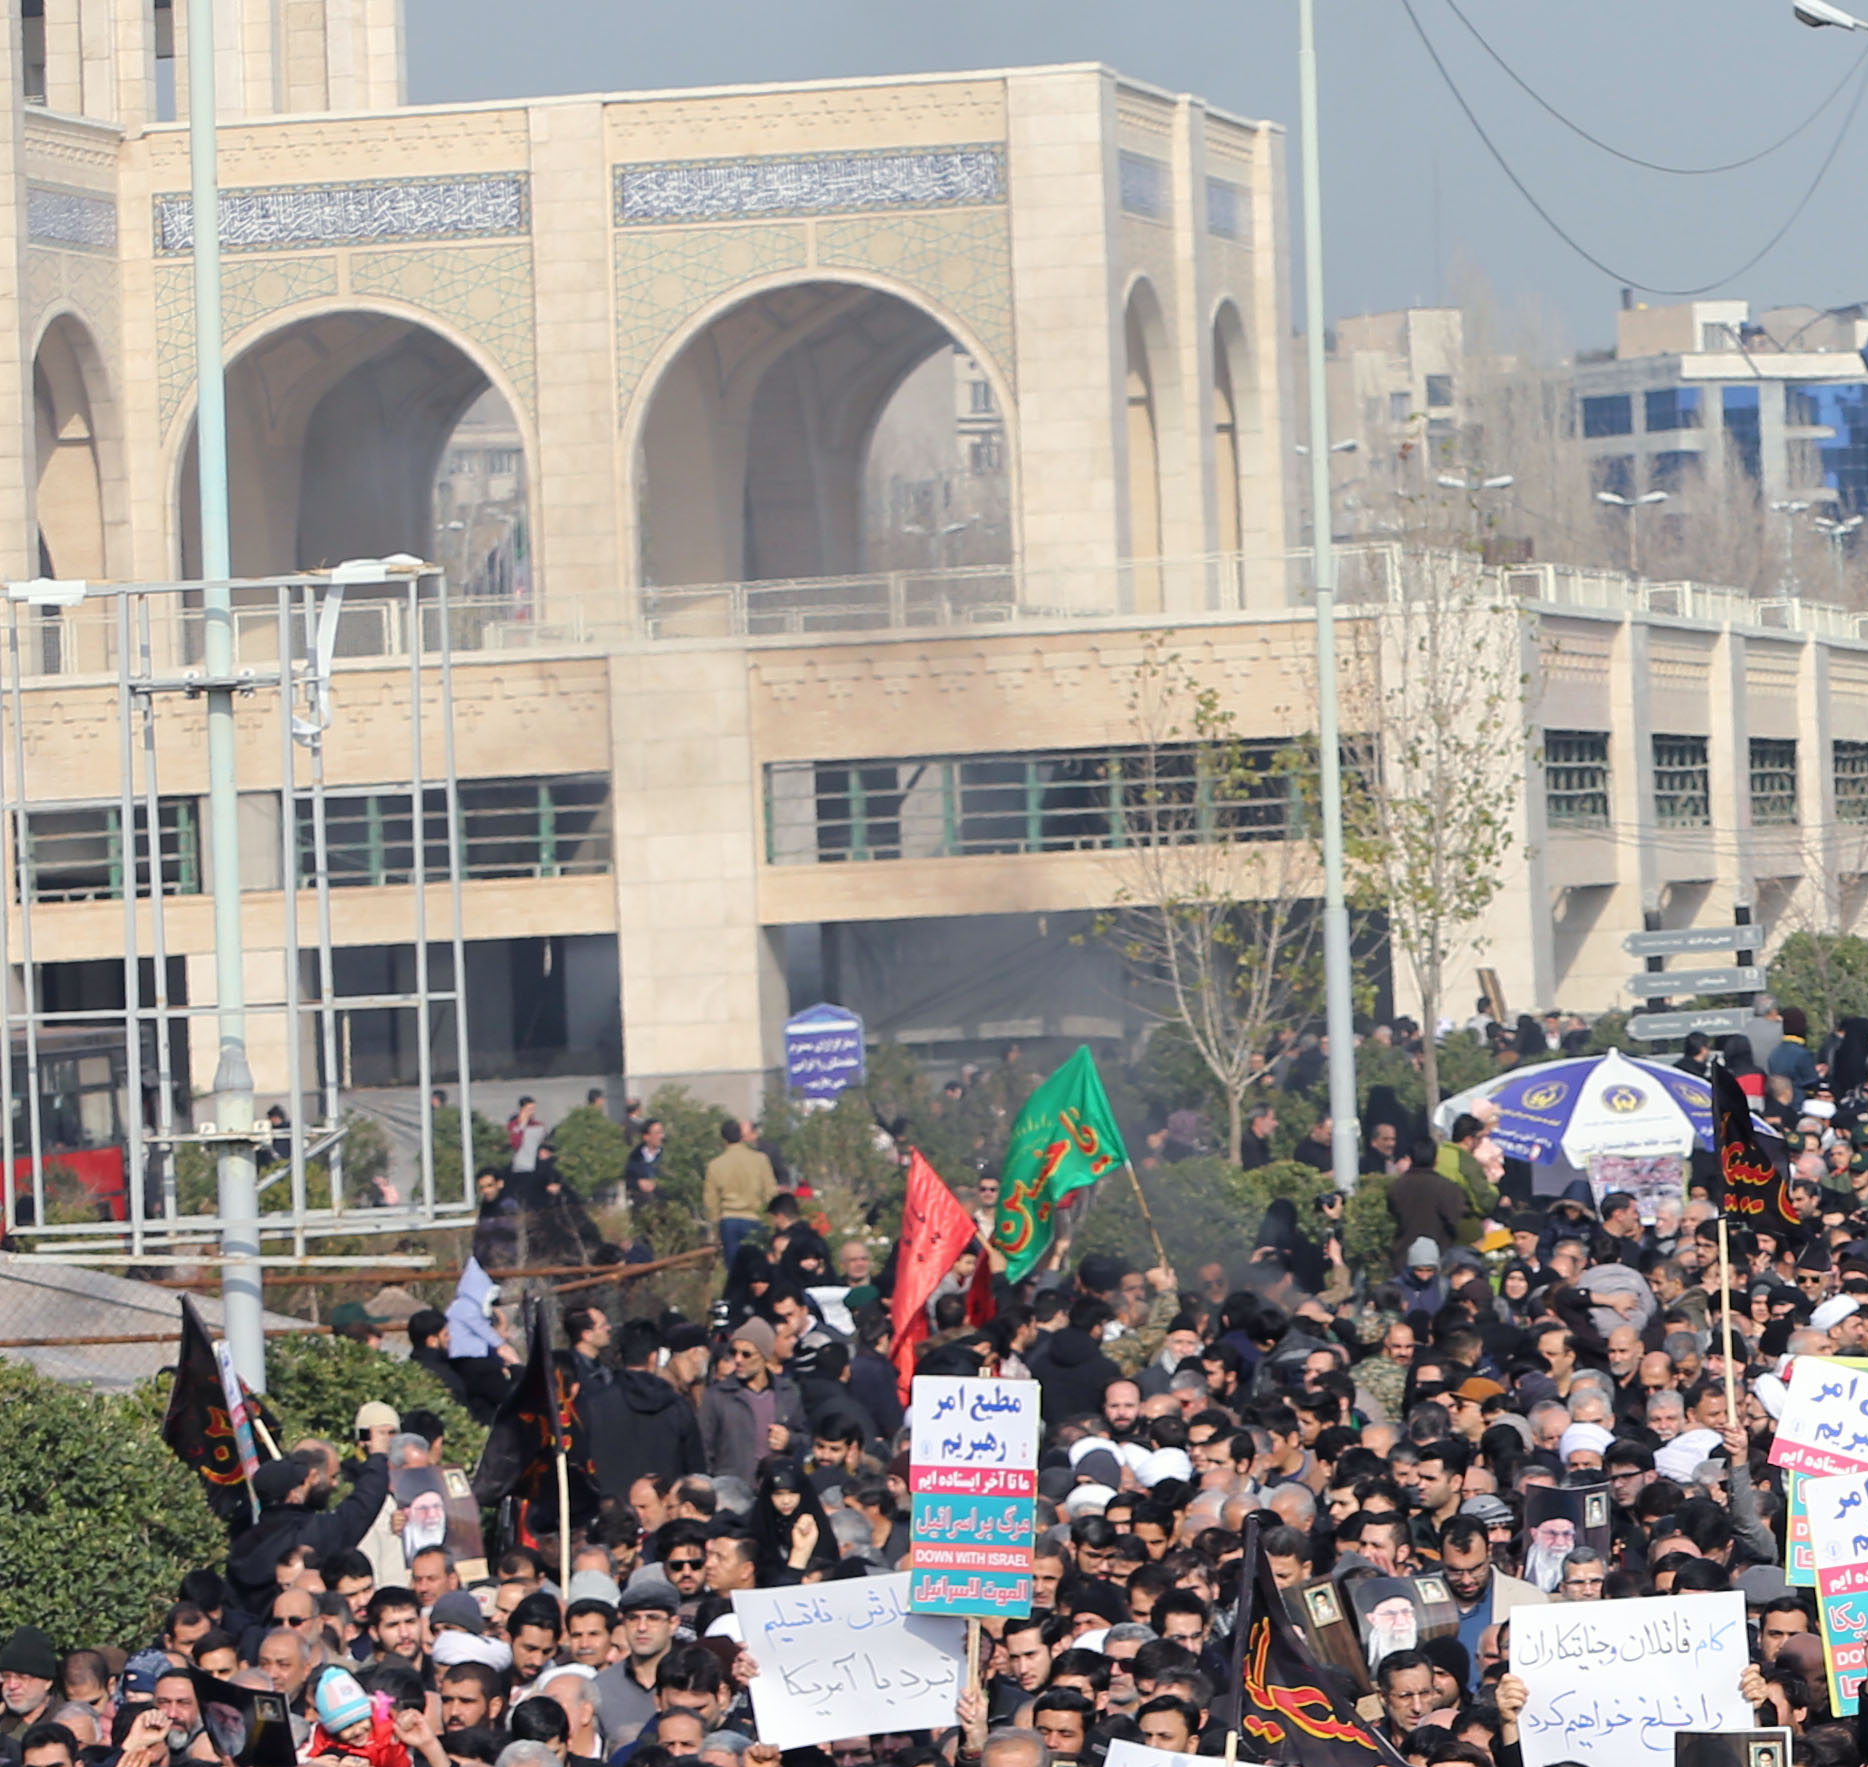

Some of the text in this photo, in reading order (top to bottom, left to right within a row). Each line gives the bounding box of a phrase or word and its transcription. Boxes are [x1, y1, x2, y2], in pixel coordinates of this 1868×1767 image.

[932, 1385, 1022, 1422] مطیع امر
[1810, 1377, 1858, 1401] امر
[941, 1432, 1006, 1462] رهبریم
[1779, 1449, 1803, 1468] ایم
[918, 1470, 937, 1492] ایم
[938, 1471, 981, 1492] ایستاده
[981, 1471, 1005, 1494] آخر
[1018, 1471, 1030, 1491] ما
[915, 1504, 1030, 1541] مرگ بر اسرائیل
[915, 1549, 1029, 1568] DOWN WITH ISRAEL
[914, 1574, 1028, 1605] الموت لاسرائیل
[1829, 1571, 1854, 1594] ایم
[1621, 1611, 1691, 1661] قاتلان
[1695, 1620, 1736, 1668] کام
[779, 1652, 857, 1716] آمریکا
[864, 1654, 895, 1705] با
[1528, 1690, 1576, 1735] کرد
[1640, 1696, 1693, 1751] تلخ
[1701, 1693, 1723, 1731] را
